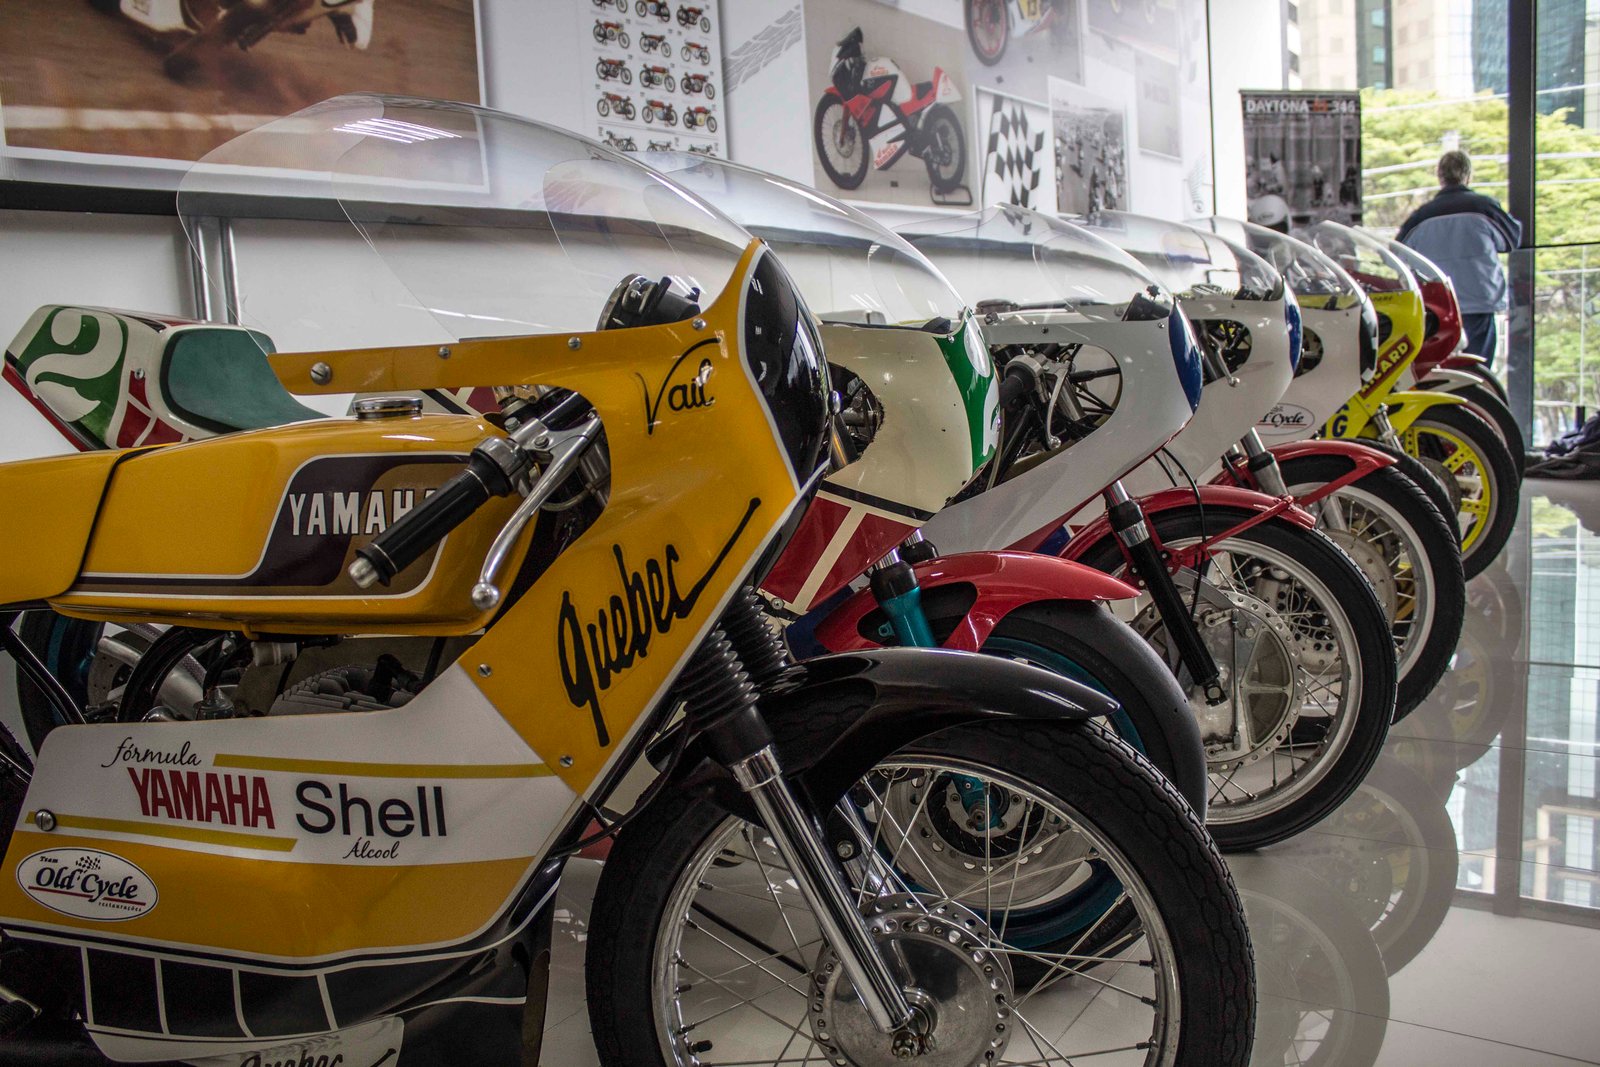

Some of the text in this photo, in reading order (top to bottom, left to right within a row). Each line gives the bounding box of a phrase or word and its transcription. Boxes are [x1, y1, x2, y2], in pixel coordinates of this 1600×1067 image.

[1246, 99, 1309, 113] DAYTONA
[1271, 412, 1304, 427] Cycle
[289, 489, 437, 536] YAMAH
[101, 736, 202, 768] fórmula
[127, 766, 447, 838] YAMAHA Shell
[40, 855, 59, 864] Team
[342, 836, 400, 859] Álcool
[35, 866, 138, 902] Old Cycle
